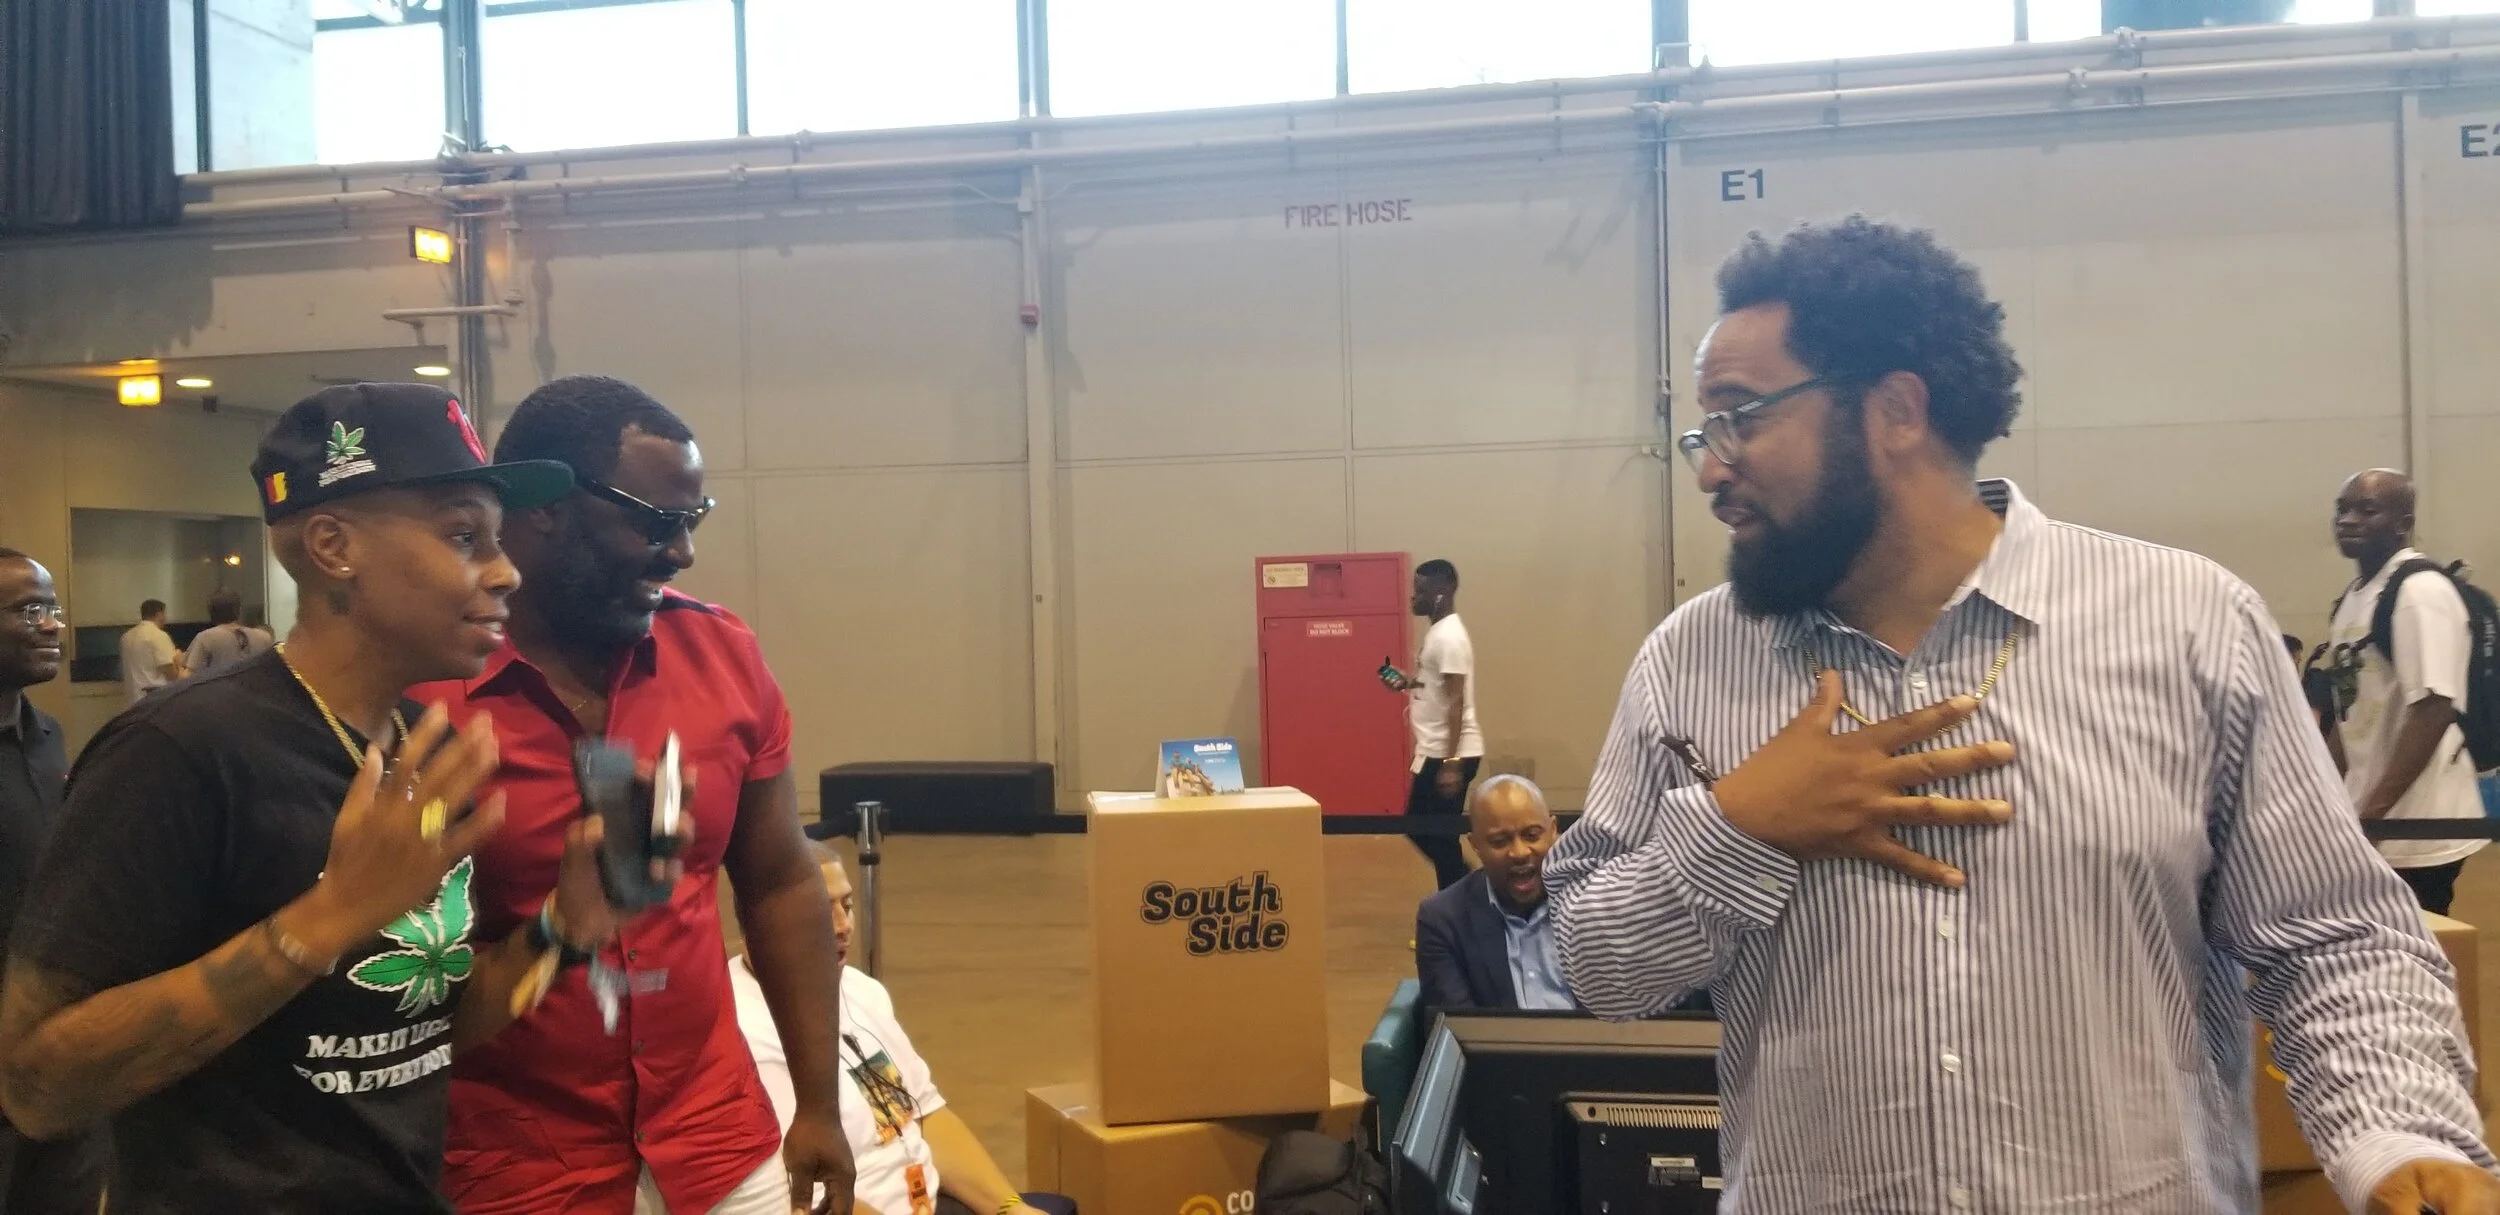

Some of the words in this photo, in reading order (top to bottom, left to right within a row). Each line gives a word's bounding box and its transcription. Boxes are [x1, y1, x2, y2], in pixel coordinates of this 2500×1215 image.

[1722, 168, 1763, 201] E1
[1284, 204, 1338, 229] FIRE
[1346, 199, 1413, 226] HOSE
[1141, 870, 1282, 924] South
[1187, 914, 1289, 956] Side
[306, 1034, 391, 1059] MAKE
[354, 1042, 453, 1092] EVERYBOD
